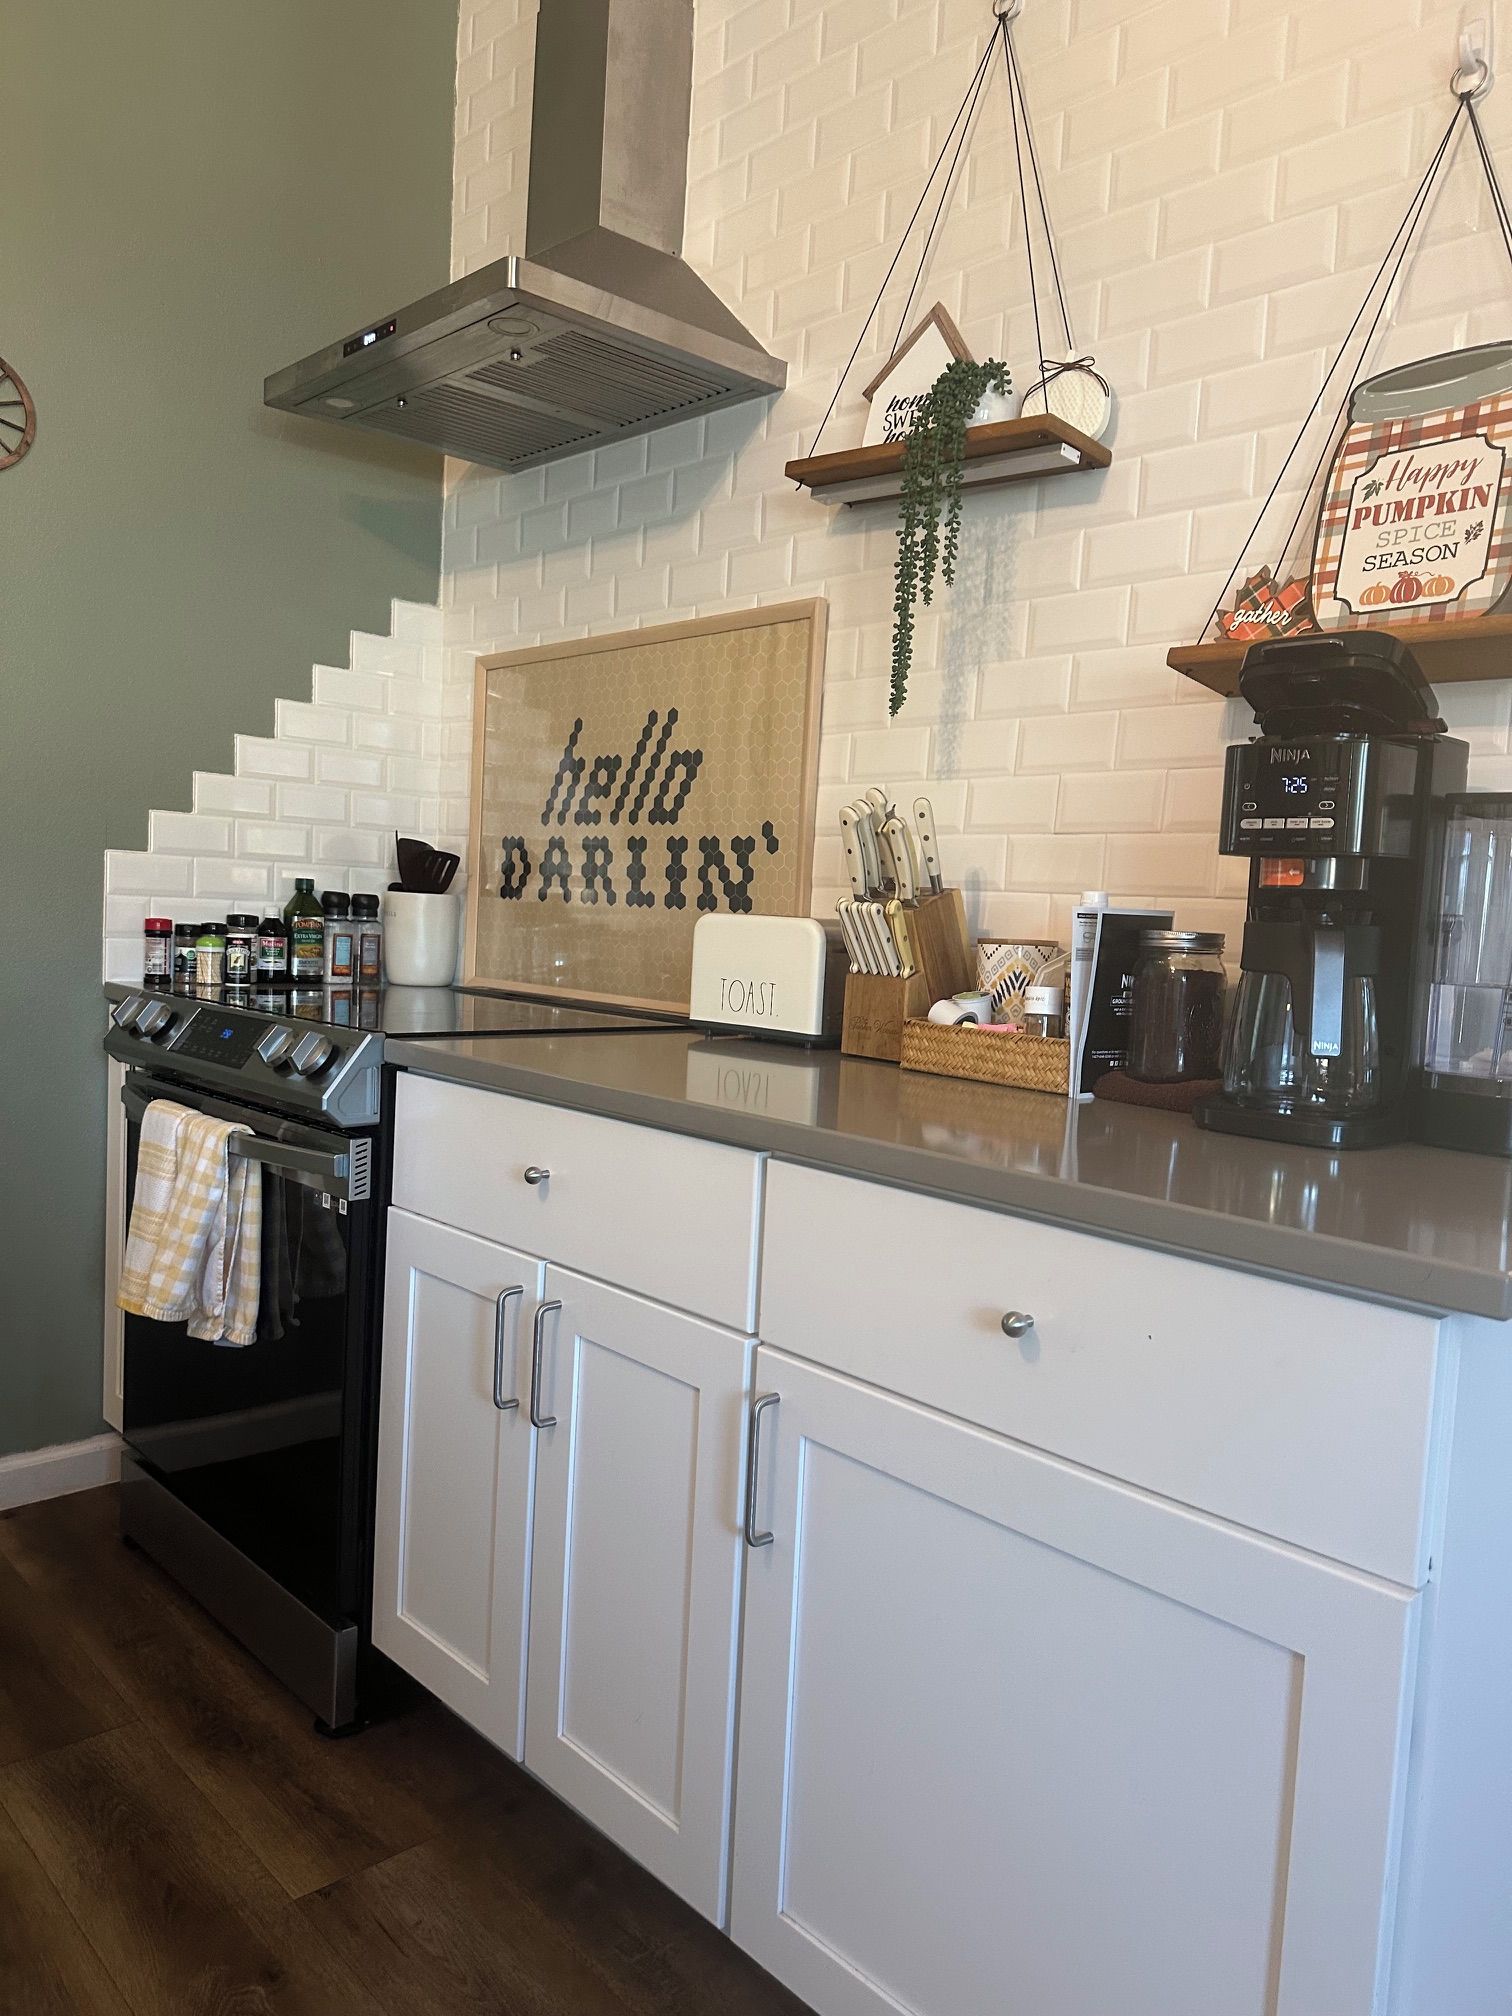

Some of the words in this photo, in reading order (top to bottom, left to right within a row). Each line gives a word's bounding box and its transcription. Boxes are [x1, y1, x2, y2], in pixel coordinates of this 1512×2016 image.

[886, 395, 930, 413] hom
[883, 410, 918, 431] SWE
[1384, 454, 1484, 493] Happy
[1351, 484, 1495, 530] PUMPKIN
[1376, 519, 1457, 549] SPICE
[1362, 542, 1459, 573] SEASON
[1233, 600, 1292, 627] gather
[541, 707, 704, 826] hello
[1270, 747, 1311, 764] NINJA
[1281, 776, 1308, 794] 7:25
[1313, 1040, 1339, 1052] NINJA
